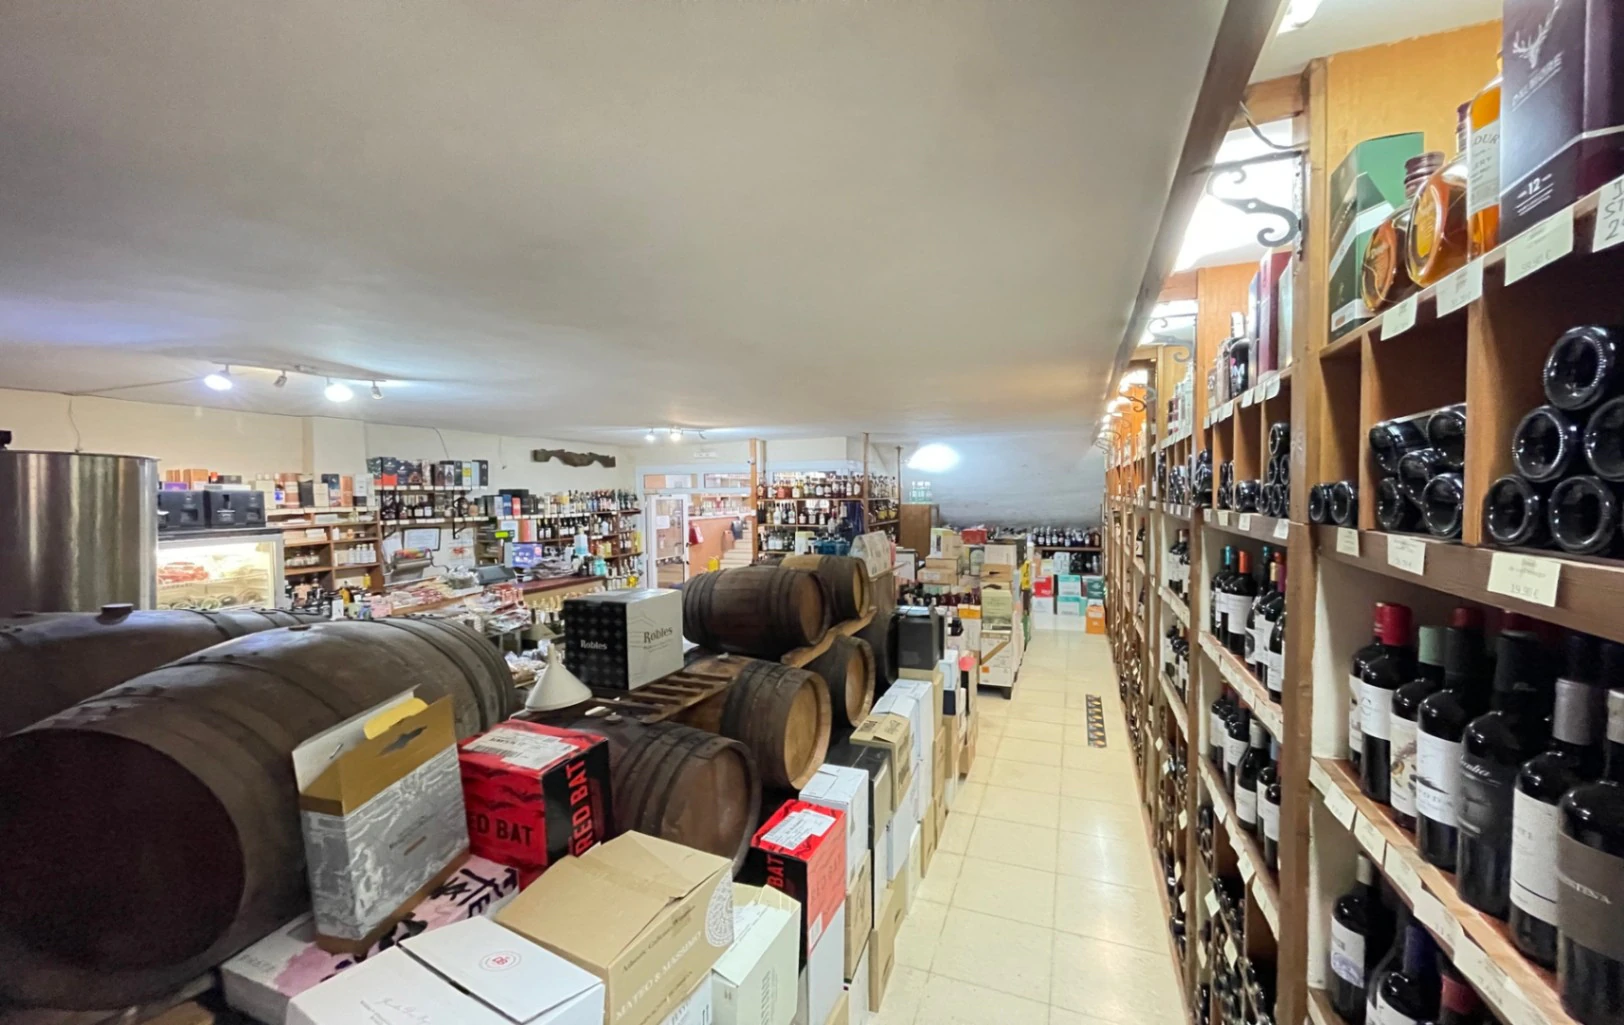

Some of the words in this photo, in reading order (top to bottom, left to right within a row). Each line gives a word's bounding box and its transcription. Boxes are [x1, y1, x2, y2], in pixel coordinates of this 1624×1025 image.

[1528, 177, 1541, 195] 12
[580, 639, 608, 650] Robles
[643, 625, 674, 645] Robles
[565, 760, 589, 807] BAT
[468, 812, 491, 835] ED
[496, 818, 535, 847] BAT
[571, 805, 596, 857] RED
[766, 854, 785, 888] BAT
